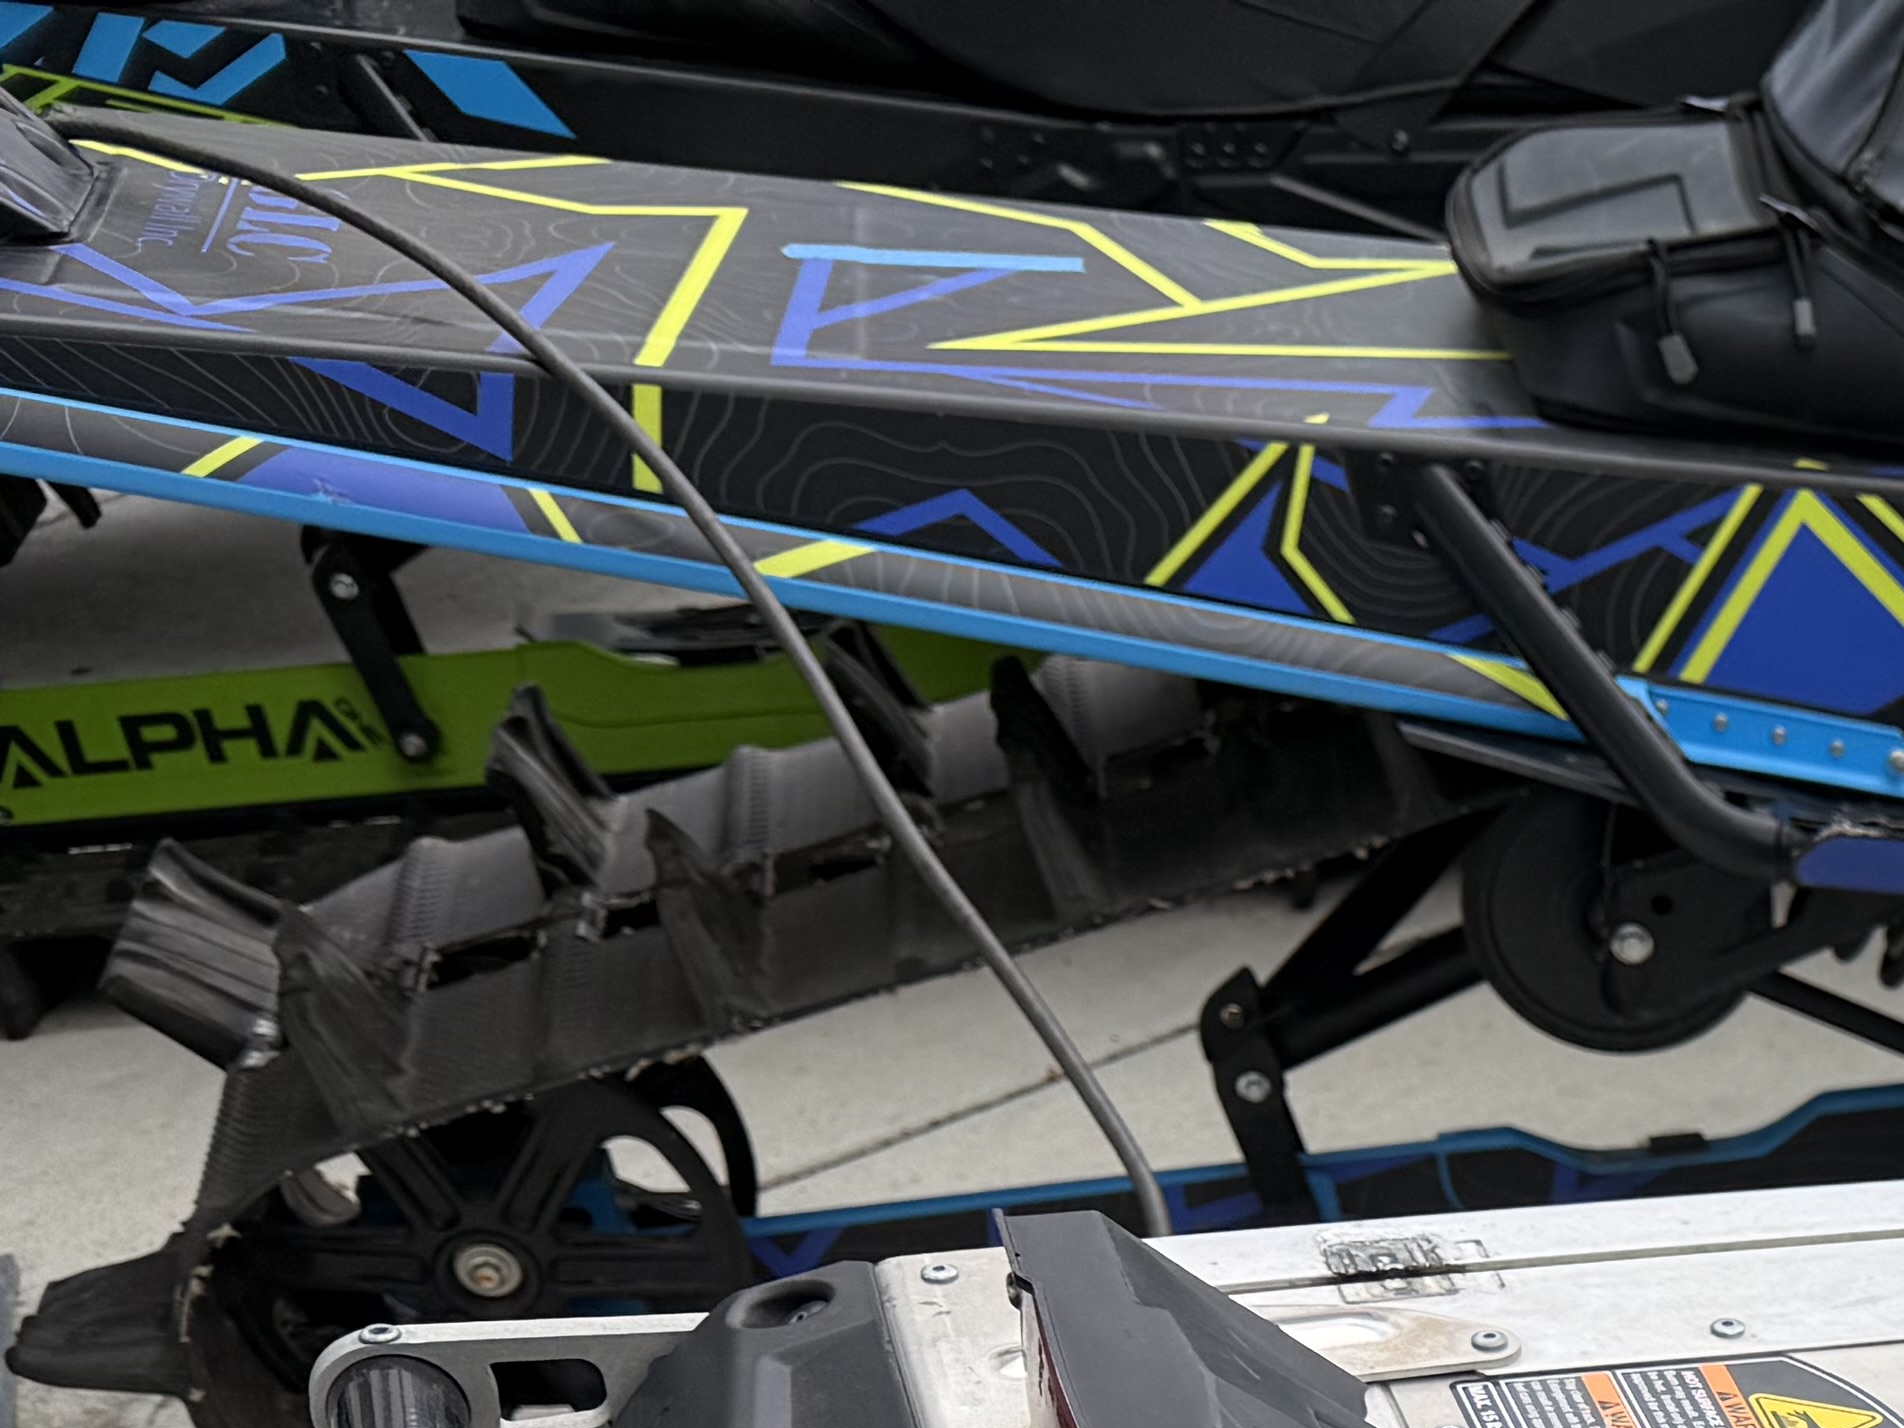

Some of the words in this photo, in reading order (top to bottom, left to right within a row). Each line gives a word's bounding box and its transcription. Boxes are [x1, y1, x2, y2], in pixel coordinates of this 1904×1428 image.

[0, 699, 364, 788] ALPHA
[1680, 1370, 1702, 1388] HOT
[1478, 1409, 1500, 1421] 15
[1690, 1388, 1724, 1426] SURFACE
